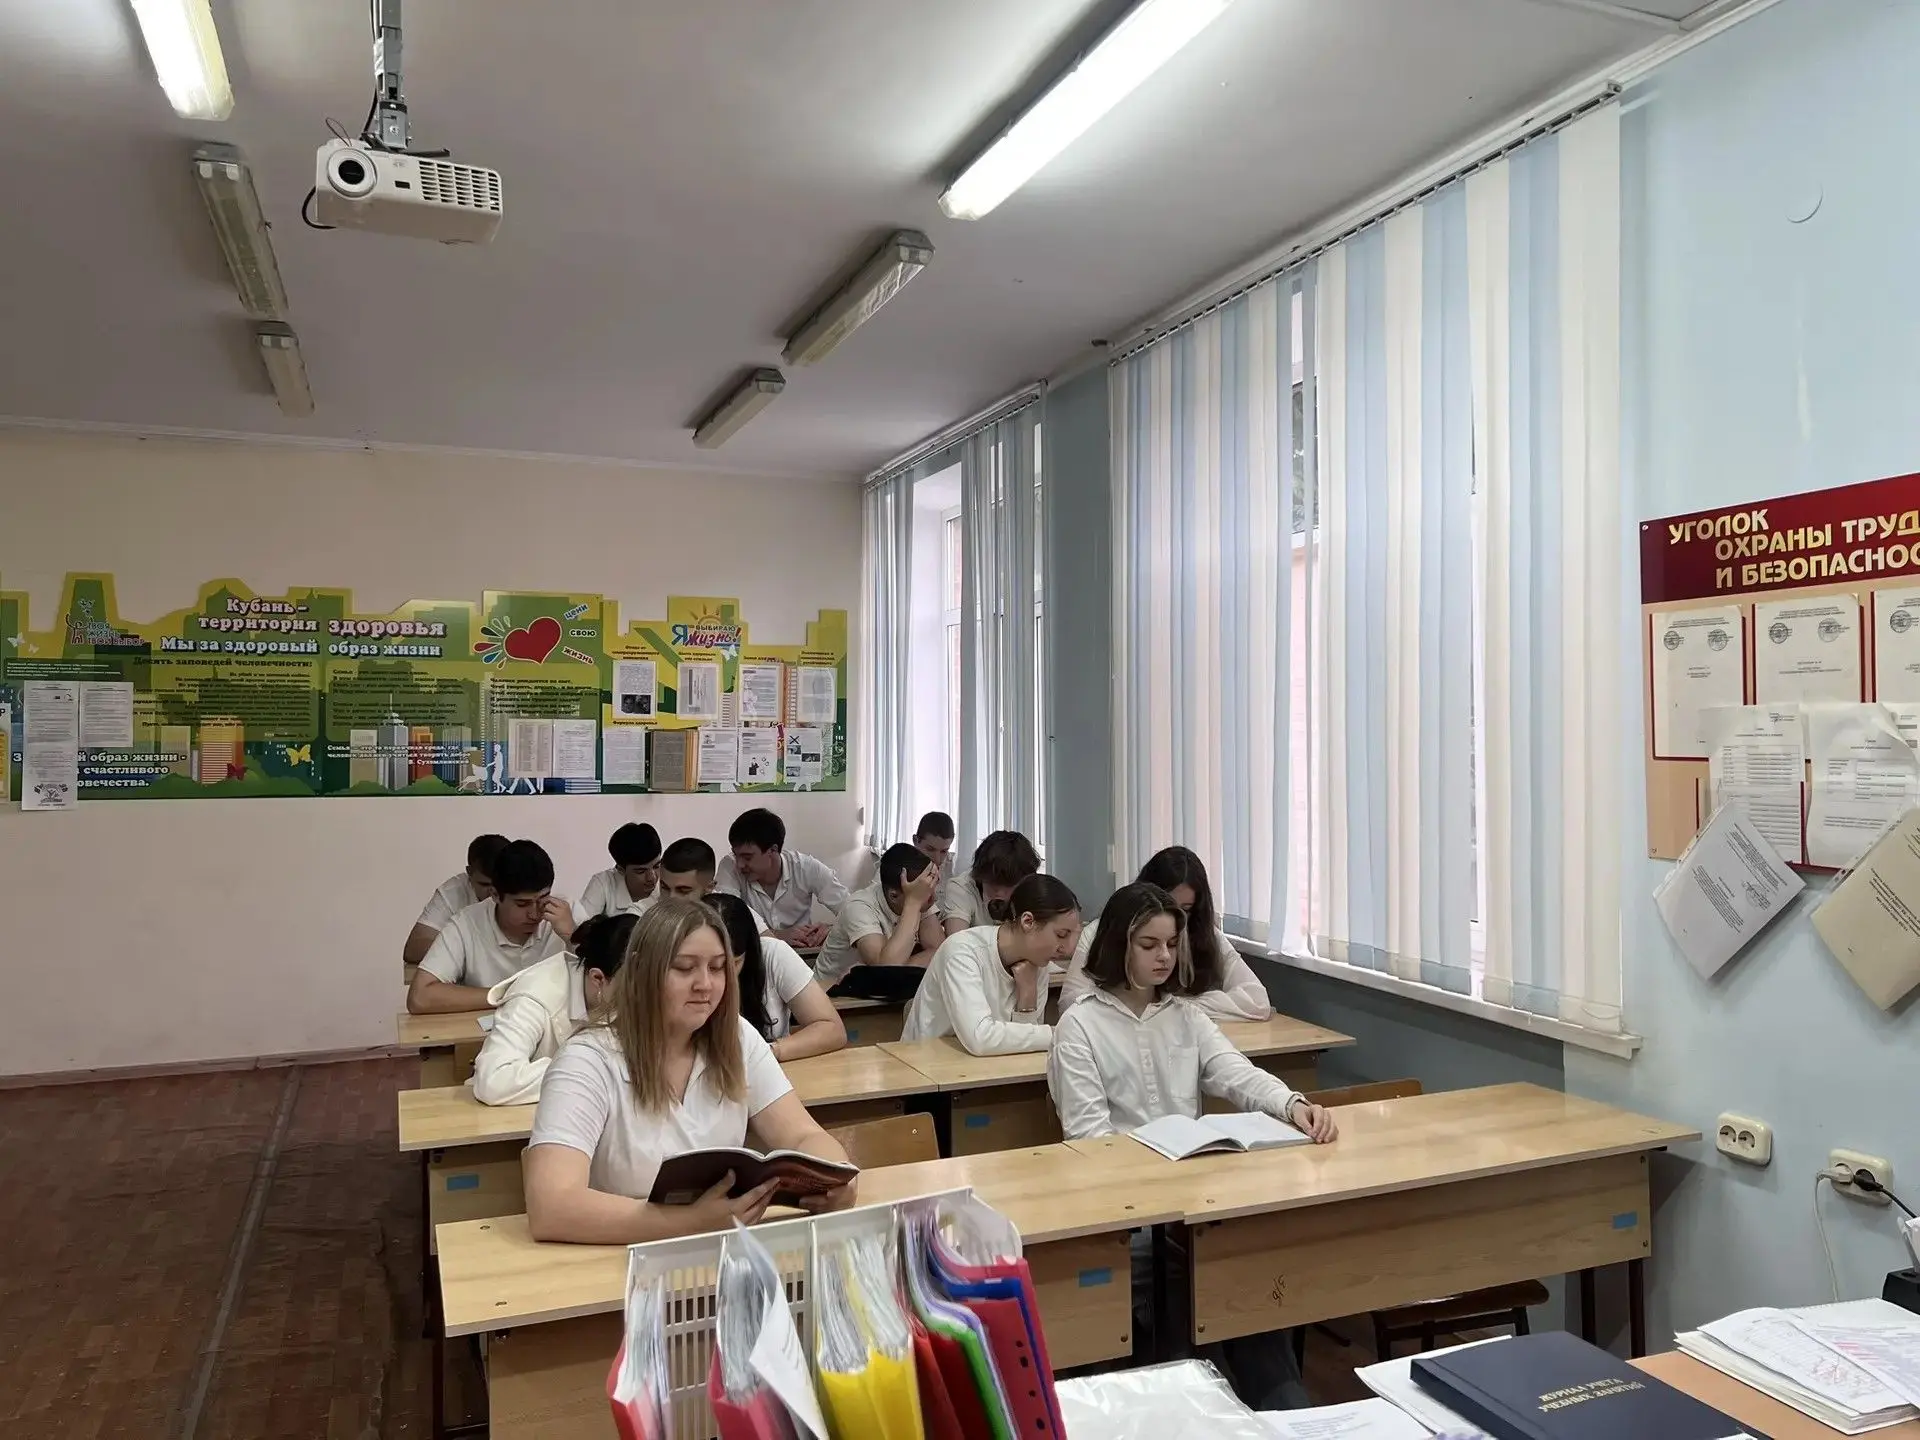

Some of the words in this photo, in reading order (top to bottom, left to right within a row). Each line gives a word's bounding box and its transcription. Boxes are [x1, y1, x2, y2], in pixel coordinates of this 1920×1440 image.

[1668, 508, 1769, 545] УГОЛОК
[1715, 523, 1832, 561] ОХРАНЫ
[1716, 566, 1733, 589] И
[226, 598, 295, 614] Кубань
[199, 617, 318, 632] территория
[328, 619, 445, 638] здоровья
[671, 624, 688, 645] Я
[161, 636, 195, 651] Мы
[200, 640, 220, 651] за
[225, 639, 319, 654] здоровый
[328, 641, 378, 659] образ
[383, 644, 441, 657] жизни
[176, 658, 233, 668] заповедей
[235, 659, 313, 668] человечности:
[90, 751, 129, 763] образ
[132, 753, 178, 762] жизни
[83, 765, 170, 775] счастливого
